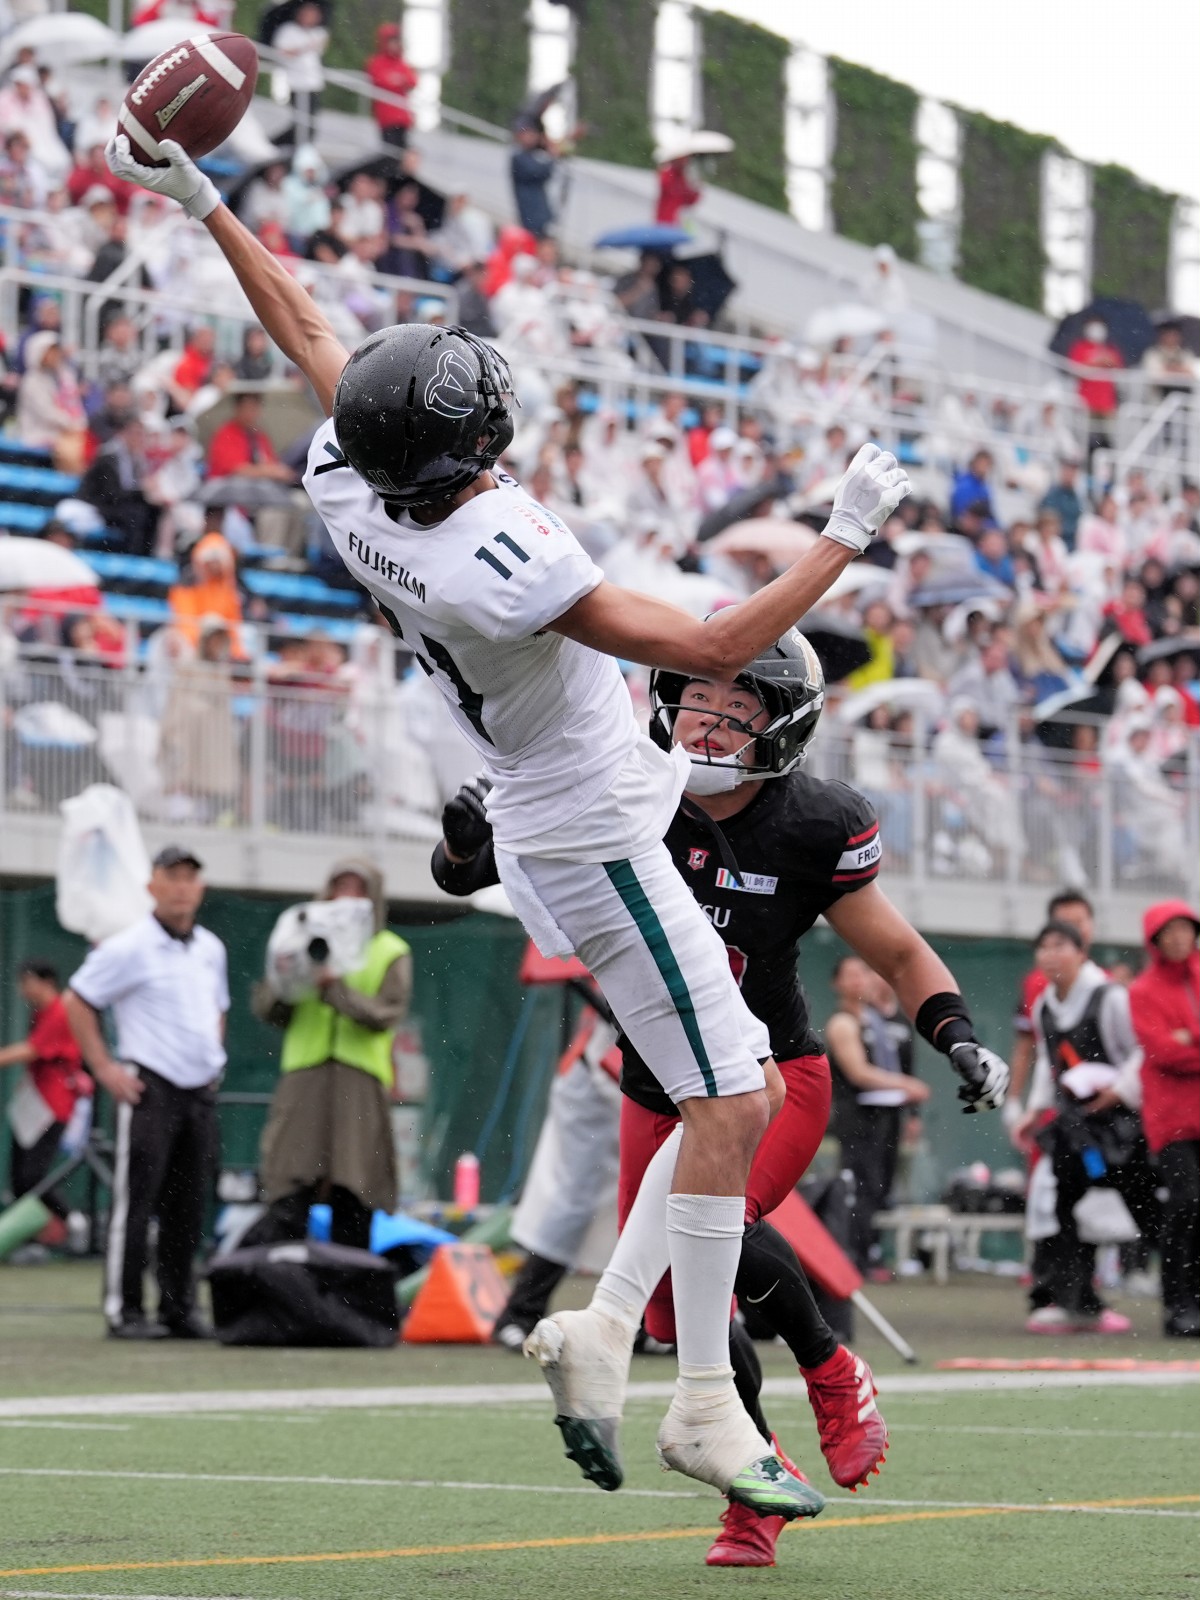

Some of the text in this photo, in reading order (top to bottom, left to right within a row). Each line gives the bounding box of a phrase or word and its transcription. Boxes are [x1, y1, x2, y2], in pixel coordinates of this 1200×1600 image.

[348, 531, 426, 604] FUJIFILM
[473, 530, 532, 581] 11
[698, 902, 732, 929] SU
